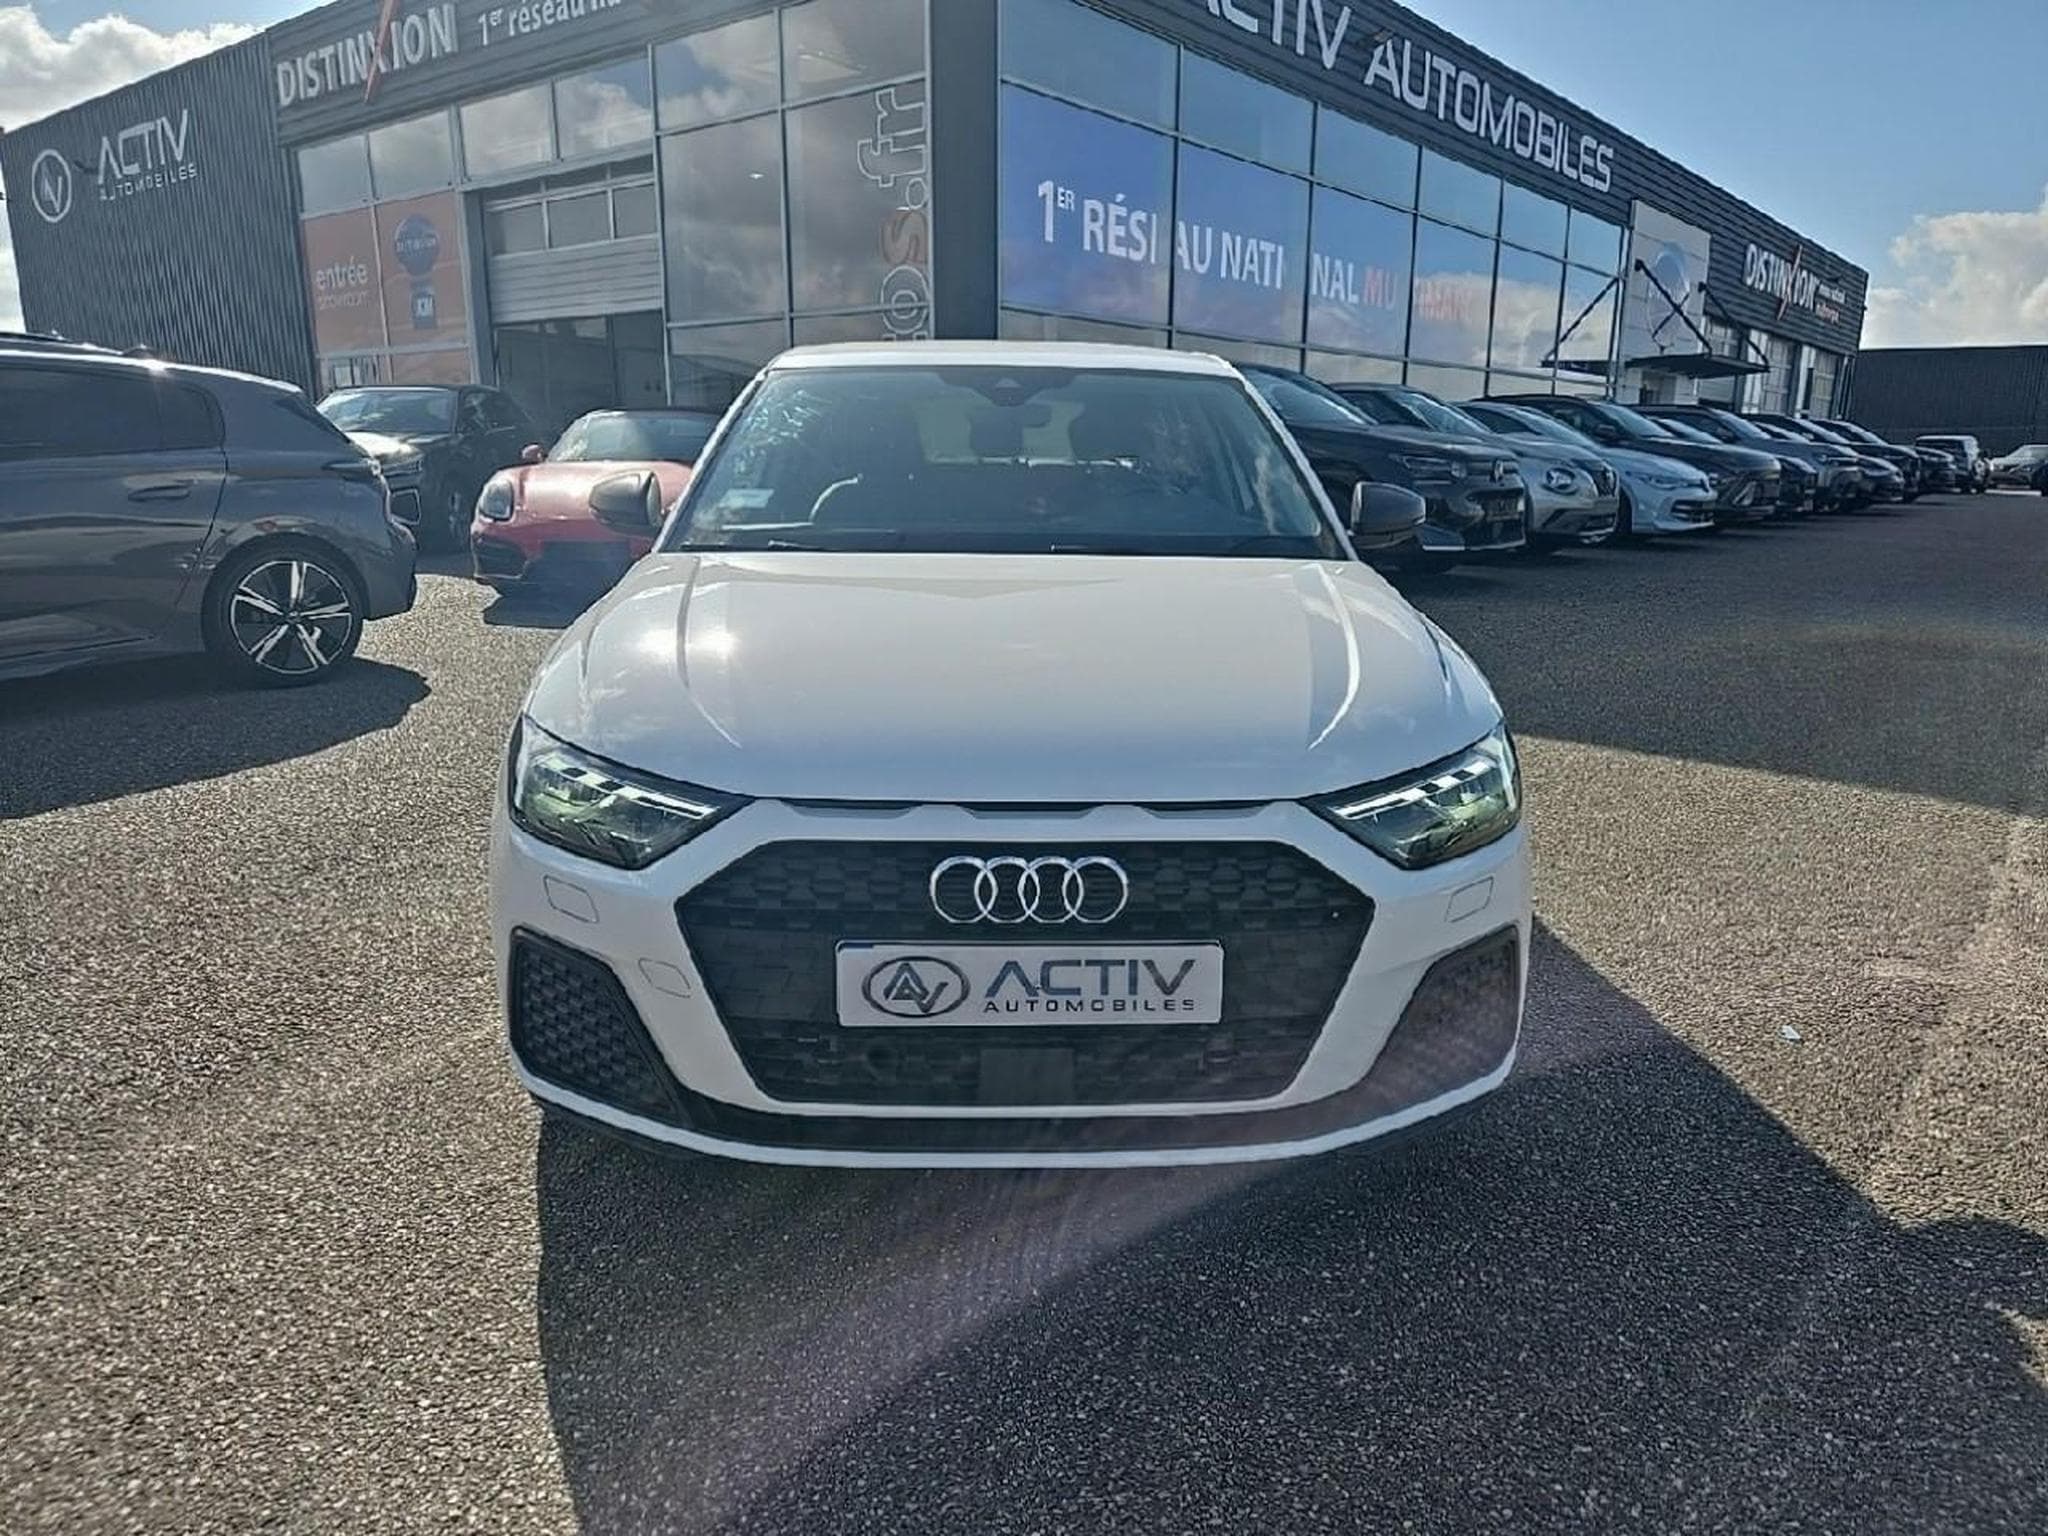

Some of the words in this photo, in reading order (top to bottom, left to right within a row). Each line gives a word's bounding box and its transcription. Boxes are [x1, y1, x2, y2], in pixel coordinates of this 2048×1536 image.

[1208, 0, 1351, 69] CTIV
[1364, 38, 1614, 193] AUTOMOBILES
[98, 109, 188, 185] ACTIV
[1038, 180, 1075, 243] 1ER
[316, 256, 368, 291] entrée
[984, 959, 1197, 998] ACTIV
[983, 999, 1196, 1014] AUTOMOBILES
